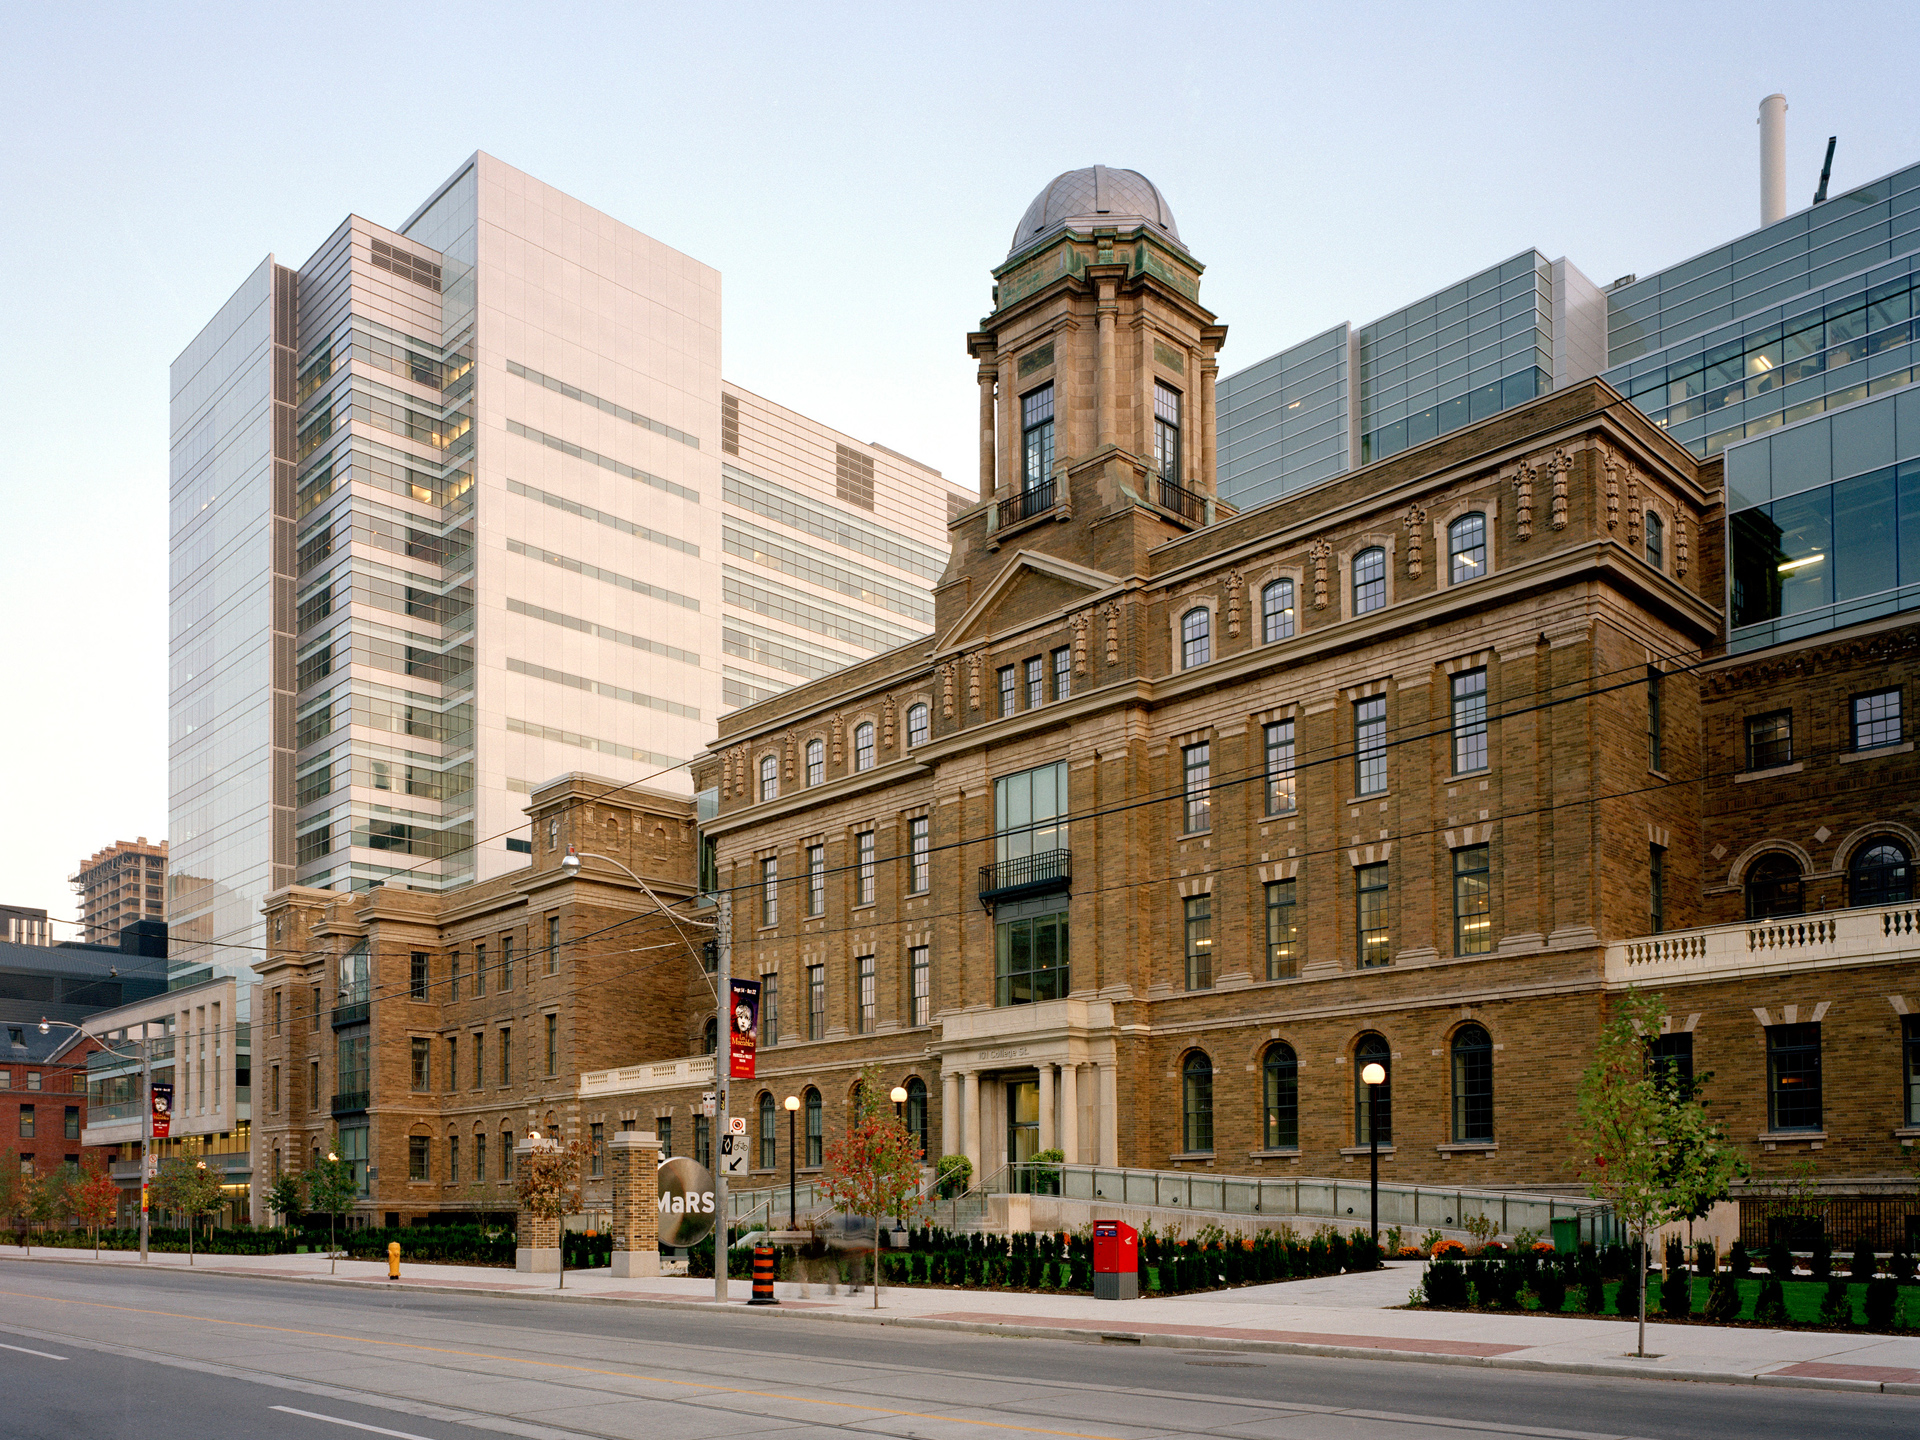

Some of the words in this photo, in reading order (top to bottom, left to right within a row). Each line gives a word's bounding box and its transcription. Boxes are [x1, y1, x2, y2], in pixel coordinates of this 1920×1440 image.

[978, 1050, 989, 1060] 101
[990, 1048, 1017, 1059] College
[658, 1191, 715, 1213] MaRS
